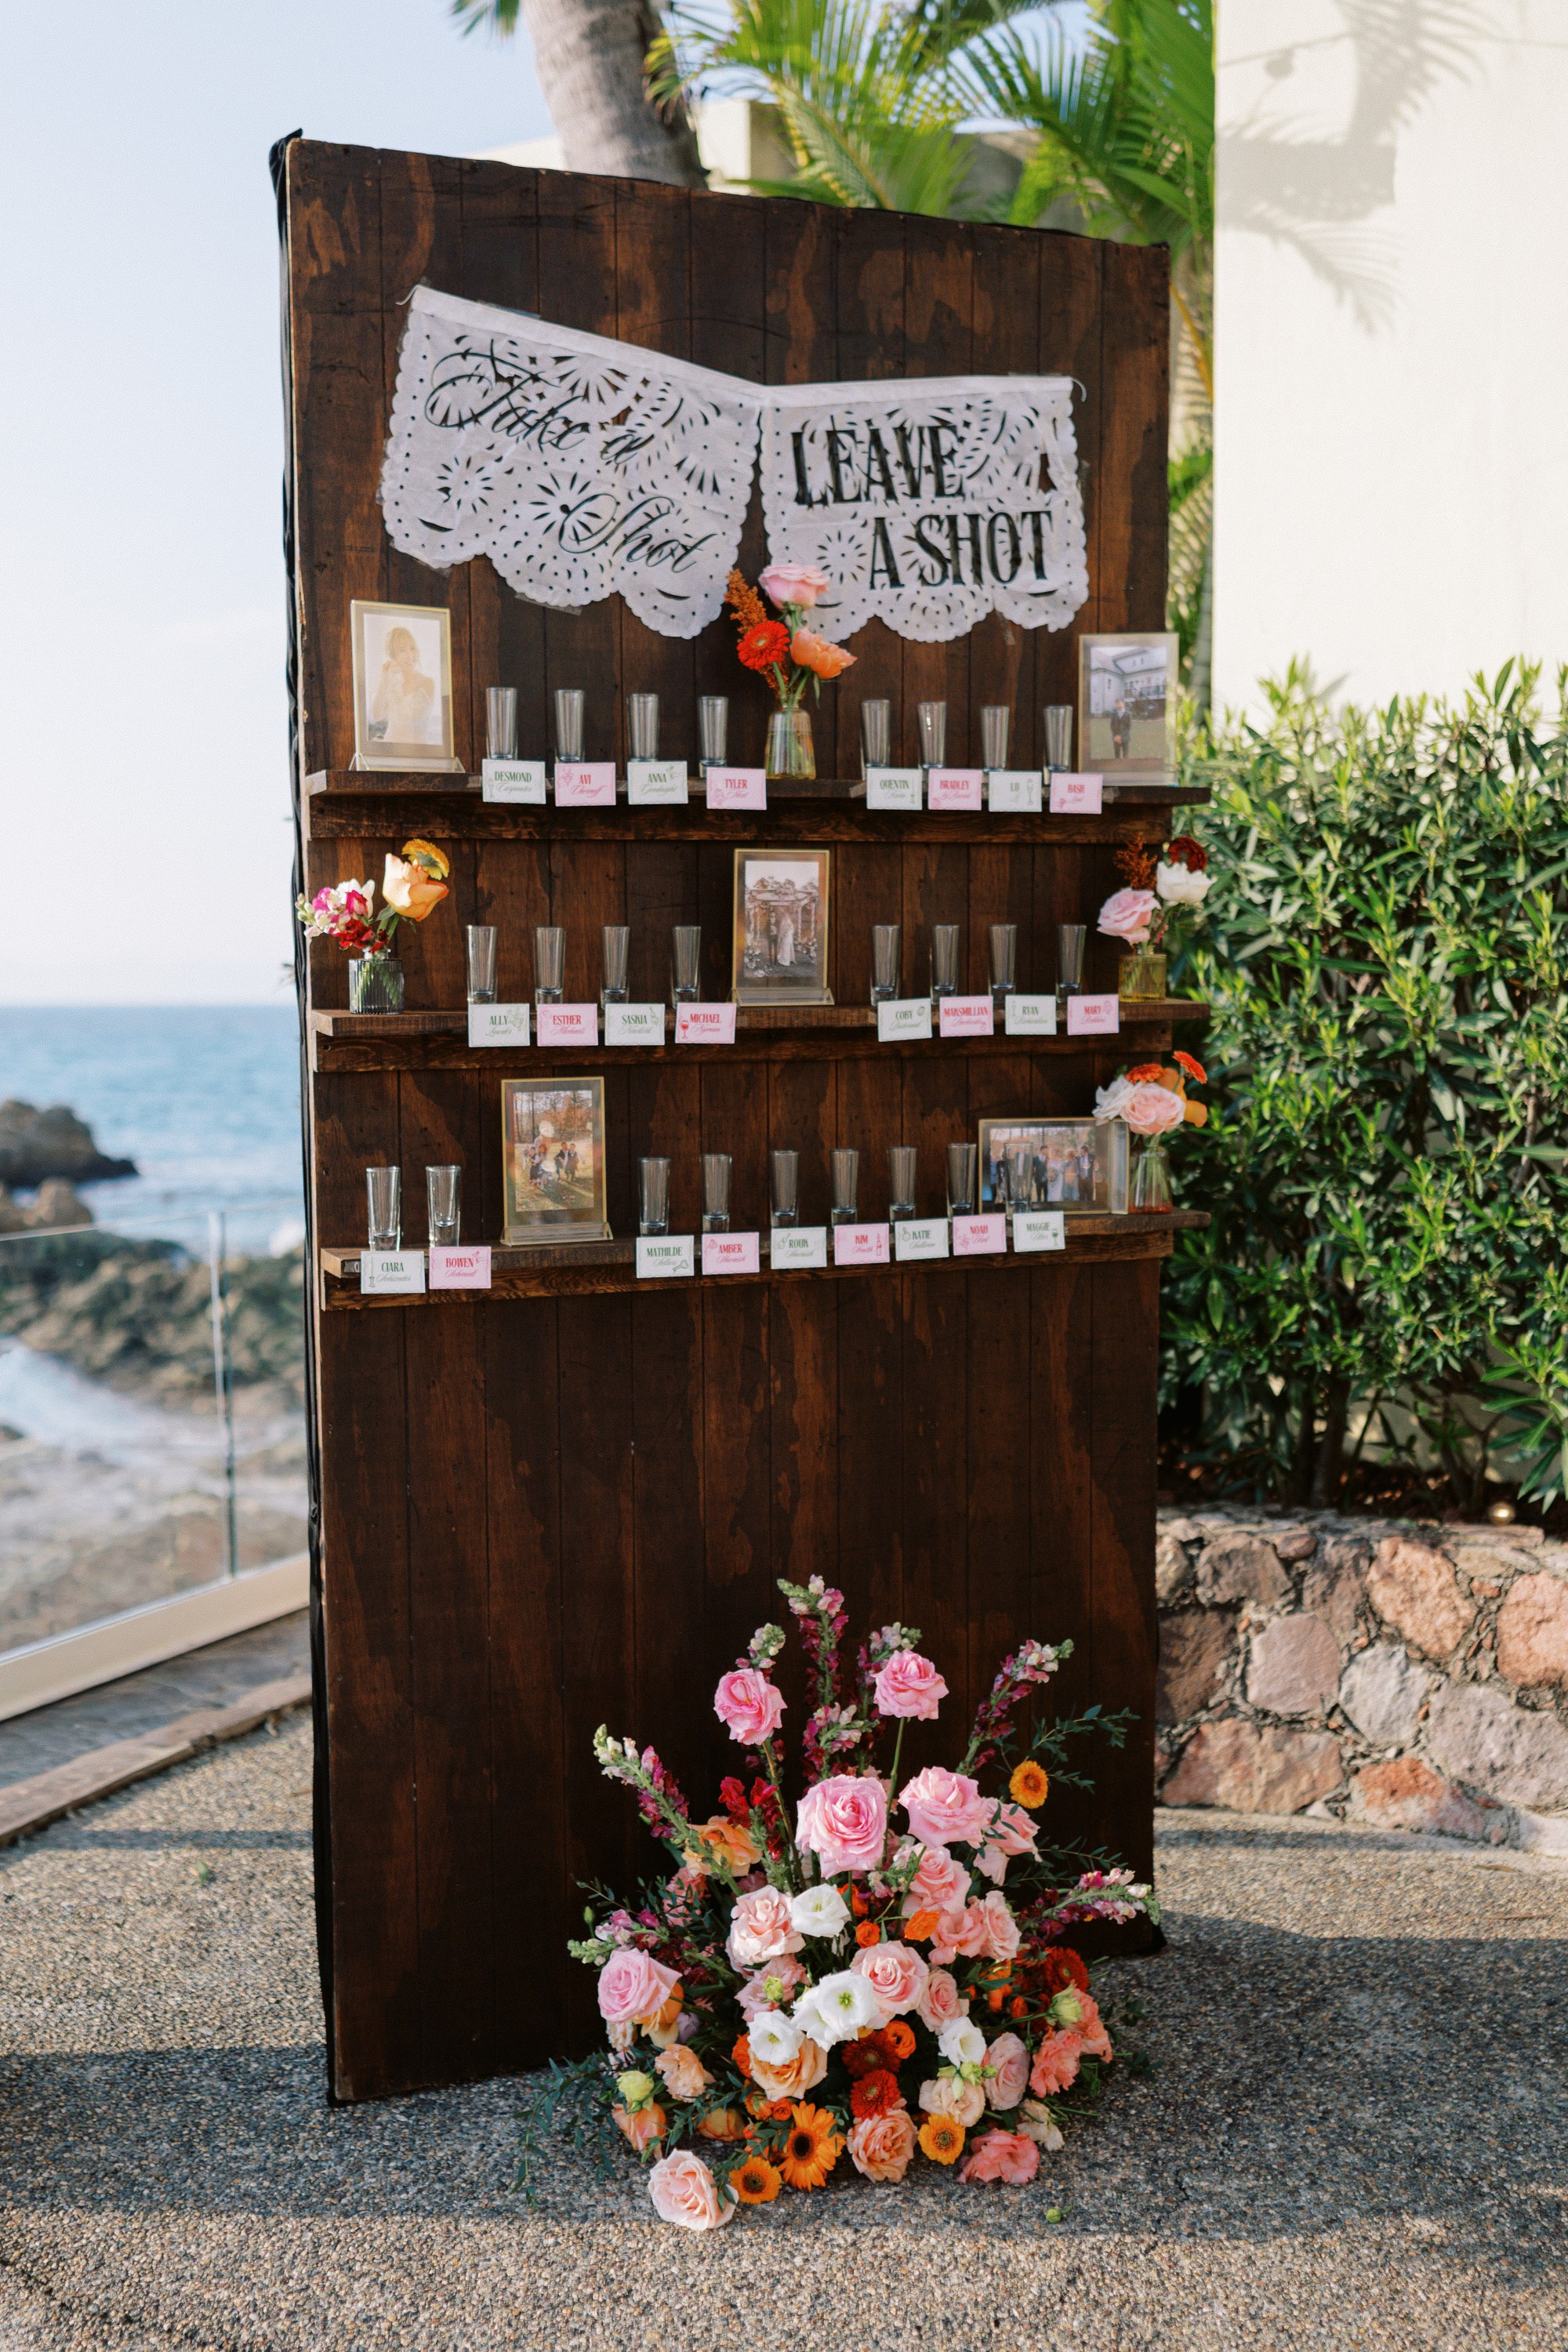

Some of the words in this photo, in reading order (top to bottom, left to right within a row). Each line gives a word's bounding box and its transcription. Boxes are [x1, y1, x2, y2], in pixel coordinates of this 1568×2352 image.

[424, 350, 590, 450] Take
[600, 431, 639, 463] a
[791, 424, 964, 506] LEAVE
[557, 492, 719, 574] Shot
[869, 517, 905, 590] A
[913, 510, 1053, 587] SHOT
[495, 771, 532, 783] DESMOND
[579, 774, 592, 785] AVI
[648, 773, 666, 783] ANNA
[724, 779, 748, 789] TYLER
[880, 779, 909, 790] QUENTIN
[939, 779, 971, 790] BRADLEY
[895, 1010, 913, 1020] COBY
[1022, 1005, 1039, 1015] RYAN
[489, 1015, 508, 1025] ALLY
[553, 1014, 581, 1025] ESTHER
[622, 1014, 648, 1025] SASKIA
[690, 1013, 721, 1024] MICHAEL
[969, 1225, 989, 1235] NOAH
[1025, 1222, 1050, 1232] MAGGIE
[855, 1234, 869, 1245] KIM
[912, 1229, 931, 1240] KATIE
[647, 1247, 683, 1258] MATHILDE
[718, 1243, 743, 1254] AMBER
[381, 1261, 405, 1272] CIARA
[445, 1258, 474, 1268] BOWEN
